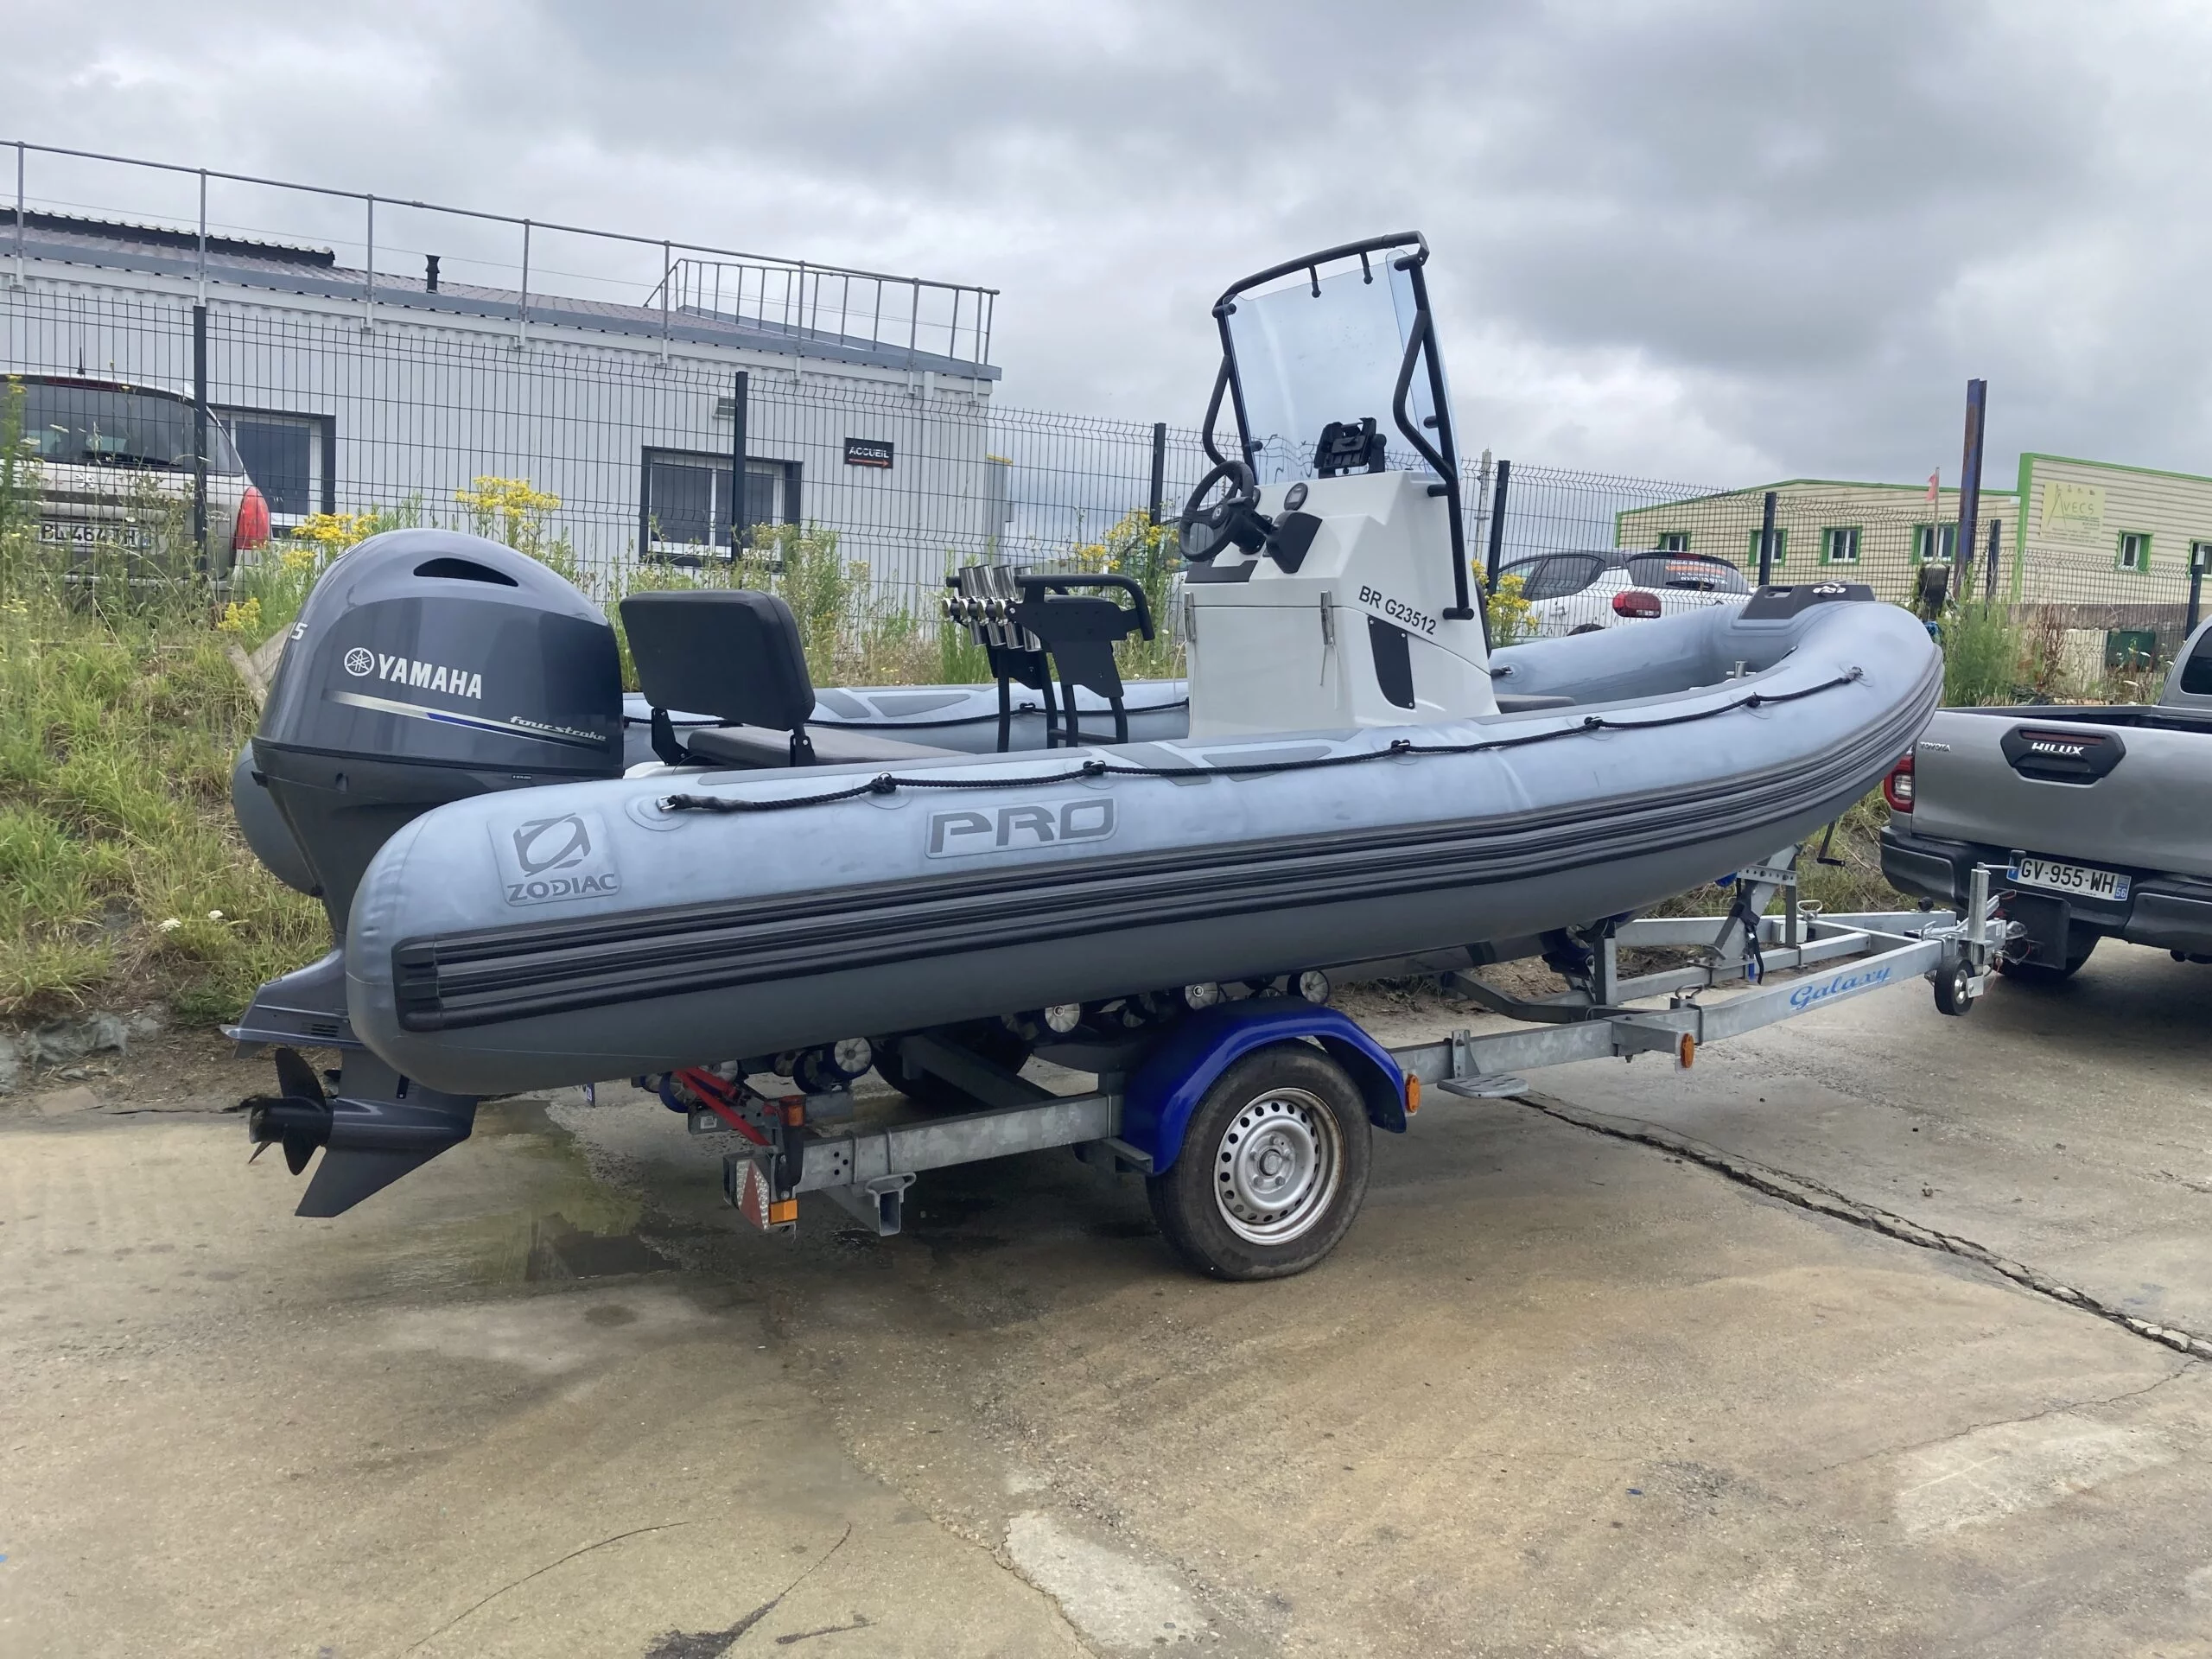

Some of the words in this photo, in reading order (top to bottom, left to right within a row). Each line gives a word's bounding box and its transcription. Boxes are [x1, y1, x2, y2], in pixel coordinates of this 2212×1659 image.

[849, 446, 890, 459] ACCUEIL
[1358, 585, 1382, 609] BR
[1385, 599, 1437, 635] G23512
[378, 653, 482, 700] YAMAHA
[1919, 741, 1951, 753] TOYOTA
[2031, 741, 2085, 756] HILUX
[930, 798, 1114, 854] PRO
[507, 874, 618, 902] ZODIAC
[2020, 860, 2116, 894] GV-955-WH
[2115, 887, 2127, 899] 56
[1789, 967, 1891, 1011] Galaxy
